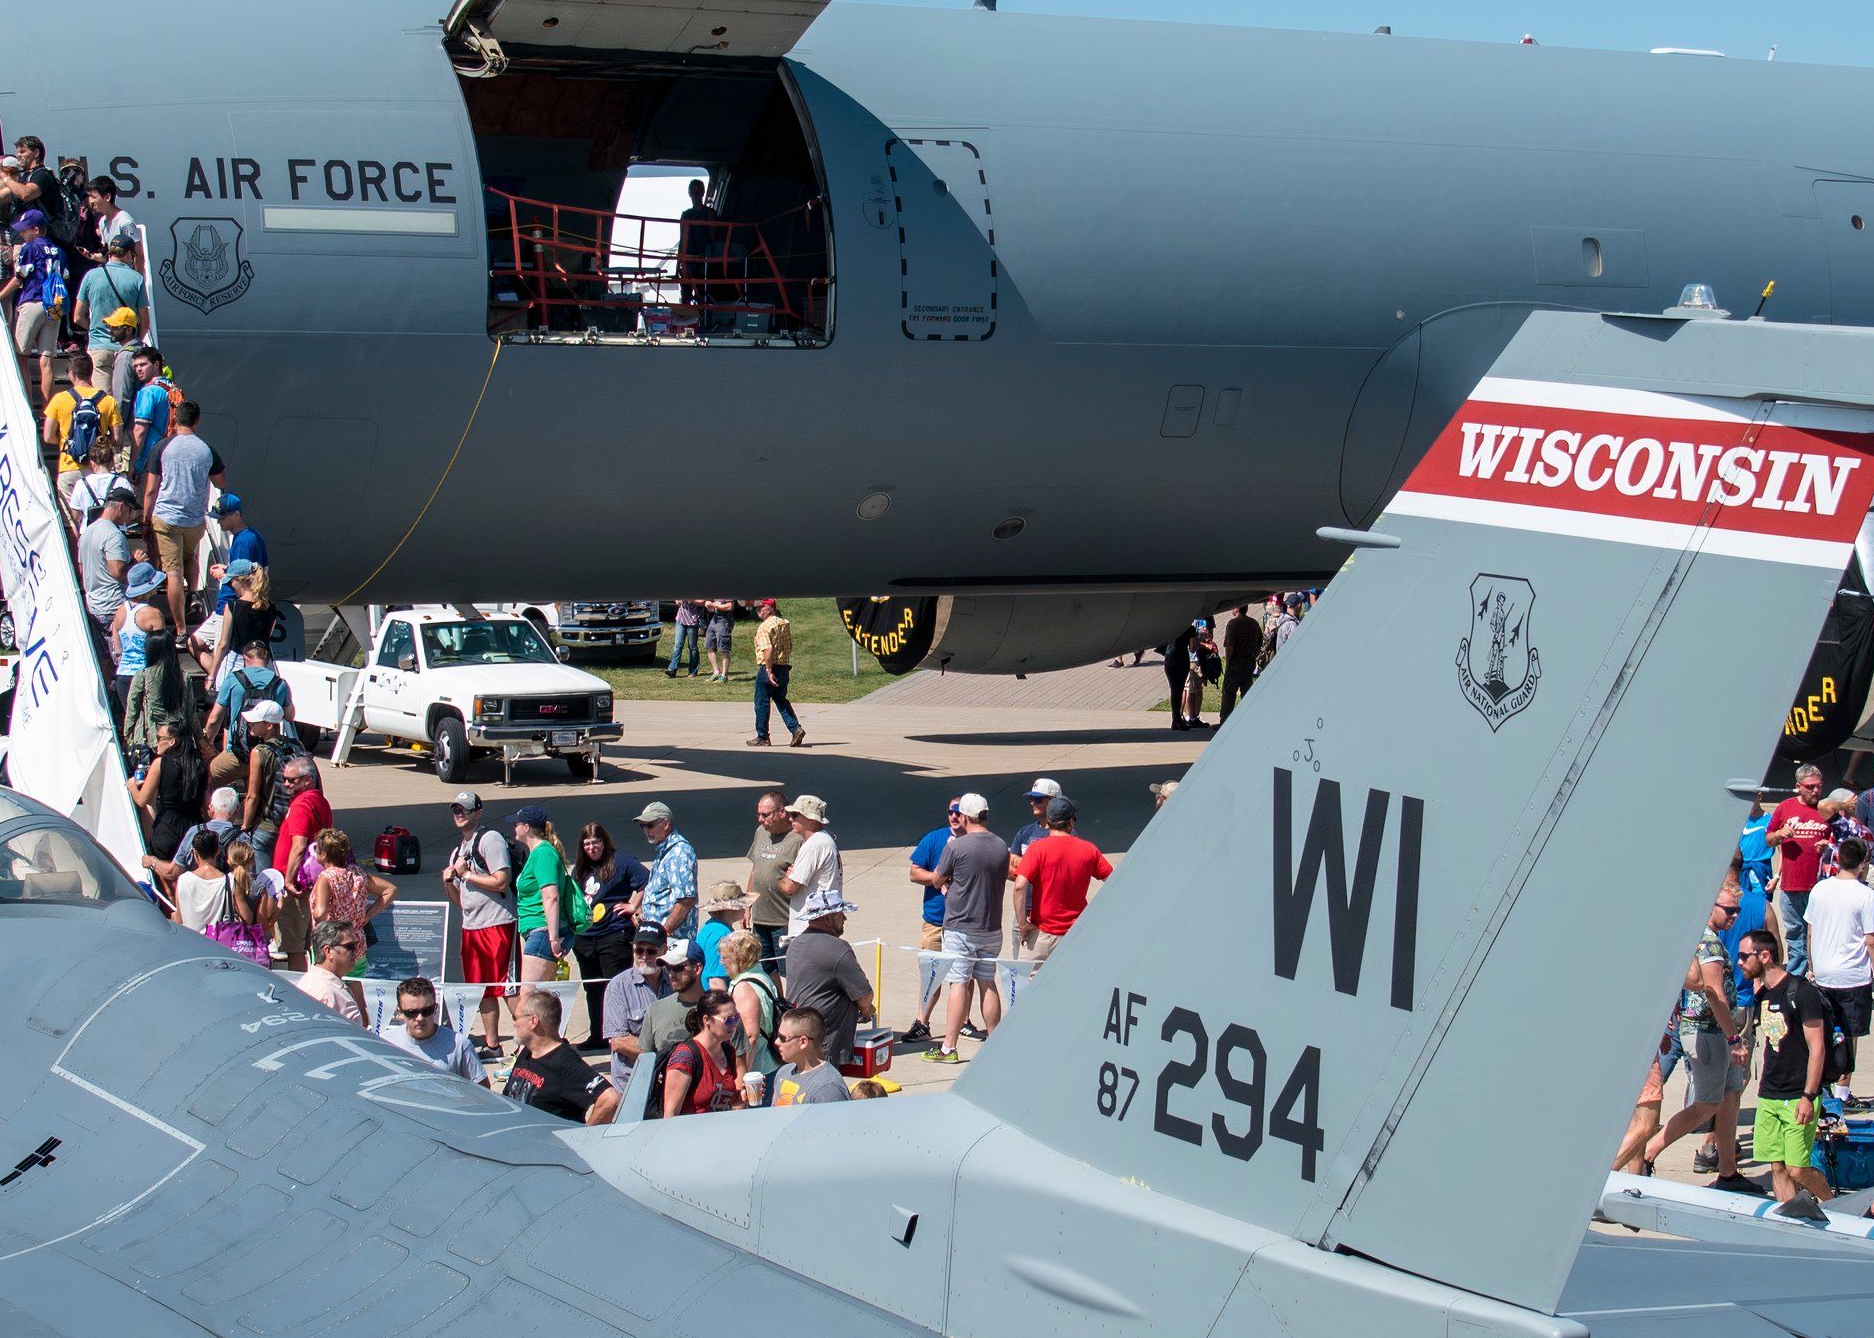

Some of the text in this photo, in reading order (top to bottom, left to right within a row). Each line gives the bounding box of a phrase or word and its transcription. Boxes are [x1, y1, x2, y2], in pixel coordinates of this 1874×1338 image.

[184, 157, 263, 200] AIR
[287, 159, 457, 204] FORCE
[166, 275, 248, 307] AIR FORCE RESERVE
[913, 305, 985, 313] SECONDARY ENTRANCE
[953, 314, 971, 322] DOOR
[1457, 422, 1862, 517] WISCONSIN
[842, 608, 914, 657] EXTENDER
[1459, 667, 1535, 720] AIR NATIONAL GUARD
[1785, 816, 1828, 832] Indian
[1272, 767, 1424, 1011] WI
[1104, 987, 1147, 1048] AF
[1096, 1062, 1140, 1122] 87
[1153, 1005, 1325, 1183] 294
